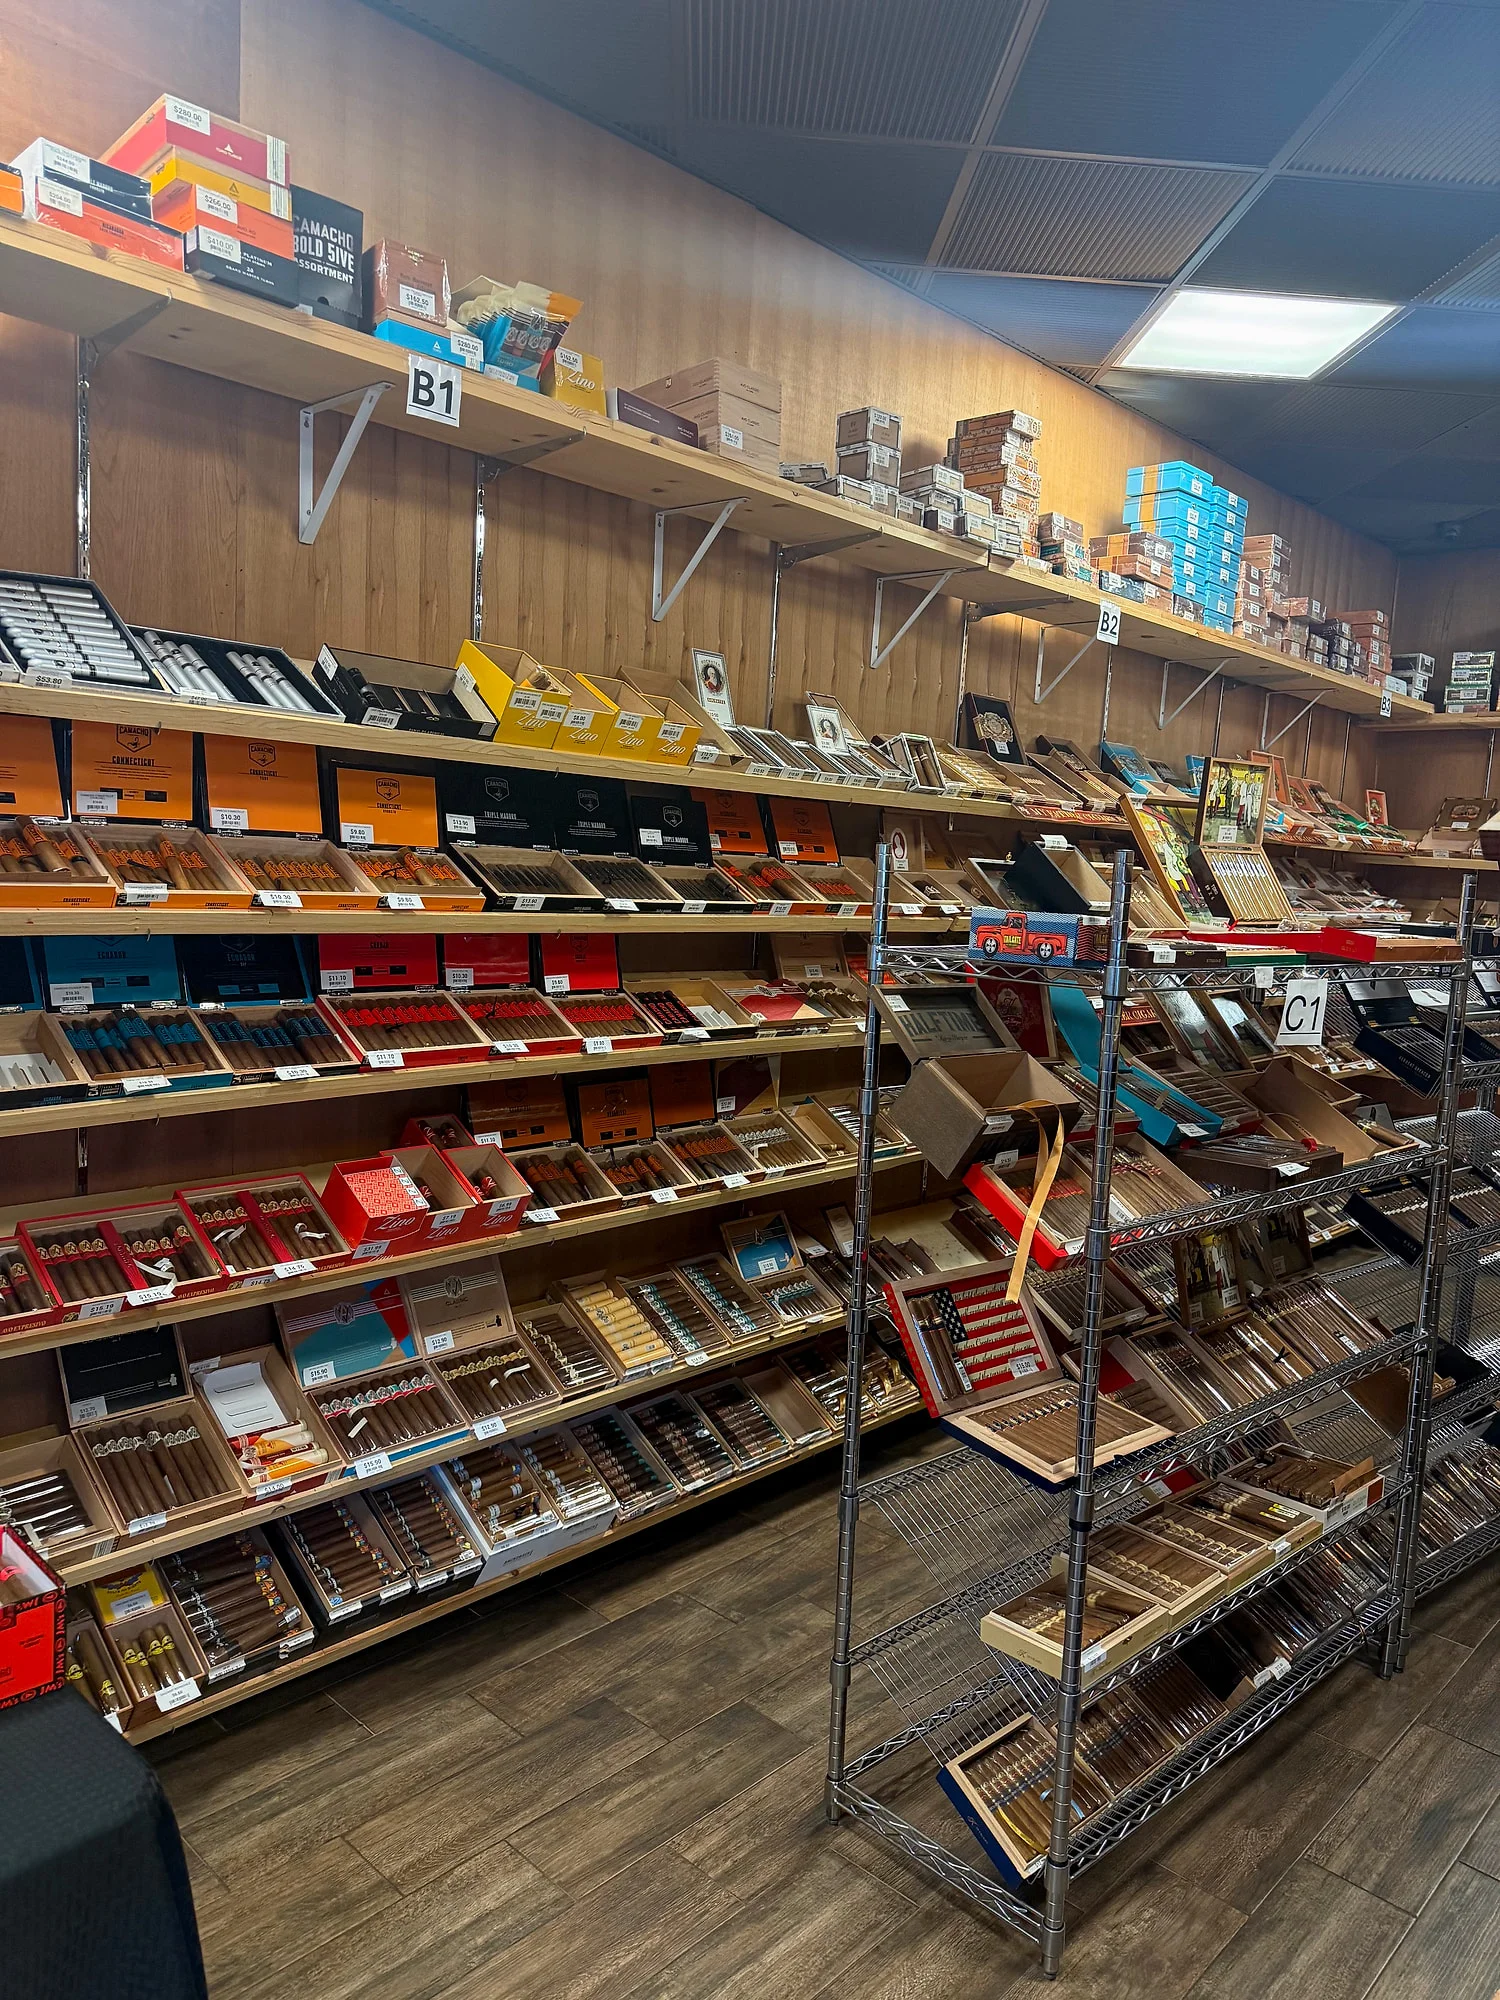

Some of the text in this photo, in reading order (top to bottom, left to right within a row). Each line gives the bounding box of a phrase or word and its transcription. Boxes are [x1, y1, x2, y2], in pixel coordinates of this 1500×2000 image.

[173, 105, 203, 122] $280.00
[204, 194, 232, 211] $266.00
[293, 215, 354, 252] CAMACHO
[207, 236, 235, 251] $410.00
[293, 234, 355, 273] BOLD 5IVE
[294, 257, 354, 285] ASSORTMENT
[567, 371, 596, 390] Zino
[411, 368, 453, 415] B1
[1100, 610, 1118, 635] B2
[35, 676, 63, 685] $53.80
[515, 711, 547, 729] Zino
[119, 726, 149, 737] CAMACHO
[569, 727, 599, 742] Zino
[617, 731, 645, 747] Zino
[250, 745, 273, 755] CAMACHO
[659, 740, 686, 754] Zino
[112, 755, 155, 767] CONNECTICUT
[220, 813, 241, 821] $10.30
[1132, 1008, 1157, 1020] CIGAR
[1285, 995, 1321, 1032] C1
[374, 1215, 416, 1232] Zino
[480, 1213, 513, 1228] Zino
[424, 1226, 459, 1241] Zino
[431, 1336, 448, 1346] $12.90
[310, 1368, 328, 1378] $15.90
[1016, 1361, 1031, 1370] $15.00
[481, 1422, 498, 1432] $12.90
[363, 1459, 382, 1469] $15.90
